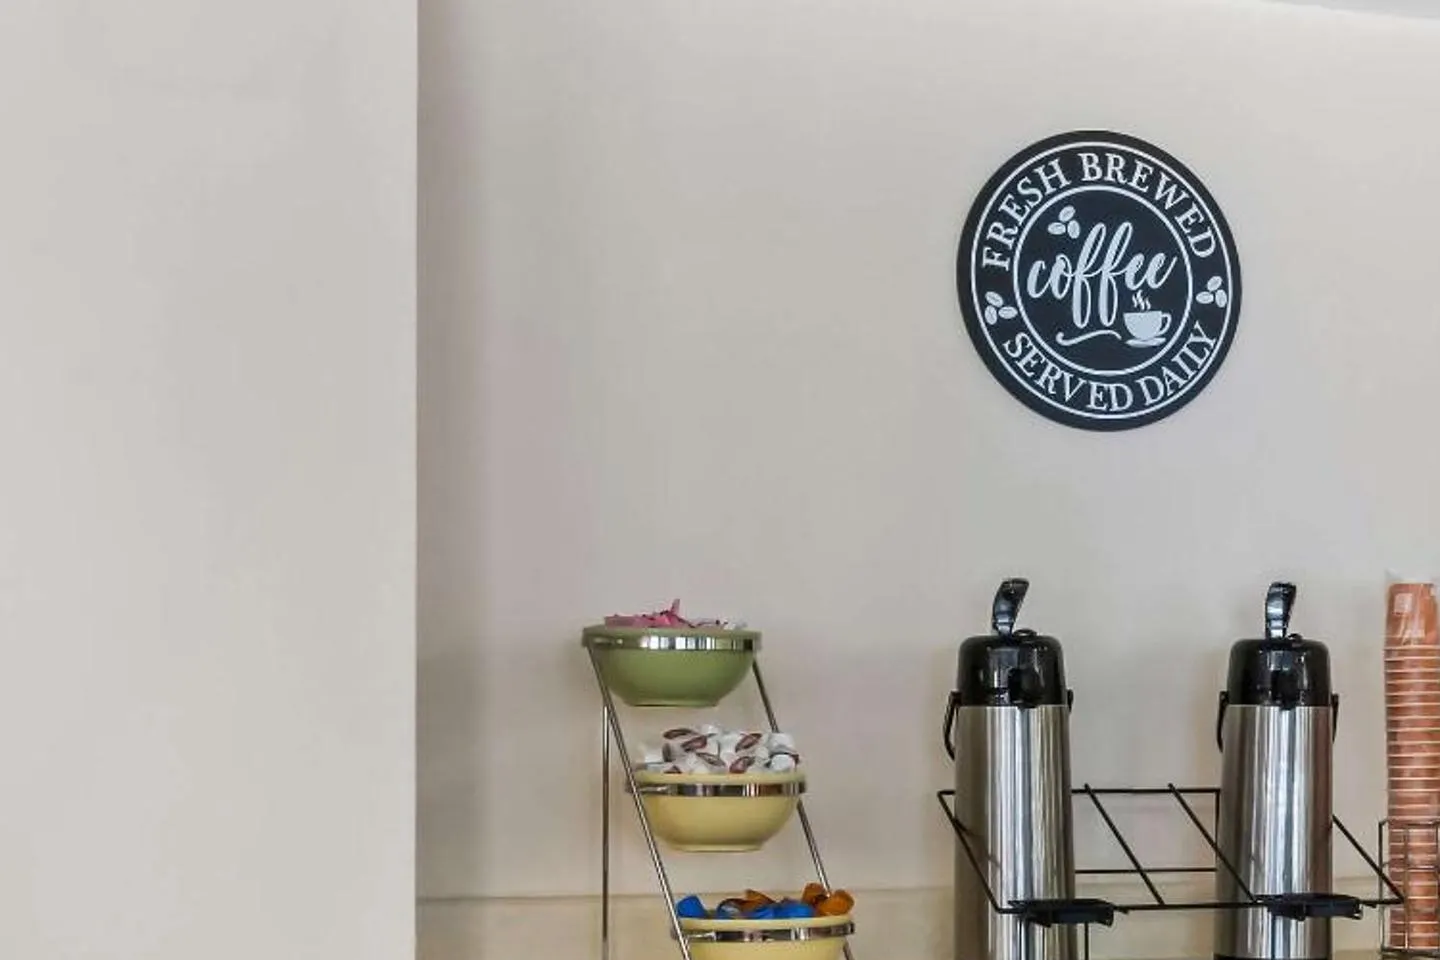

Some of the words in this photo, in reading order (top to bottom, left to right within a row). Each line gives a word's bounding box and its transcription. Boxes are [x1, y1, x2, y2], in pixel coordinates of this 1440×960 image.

[982, 158, 1072, 271] FRESH
[1078, 152, 1217, 258] BREWED
[1027, 221, 1178, 328] coffee
[1003, 332, 1133, 412] SERVED
[1136, 320, 1218, 406] DAILY
